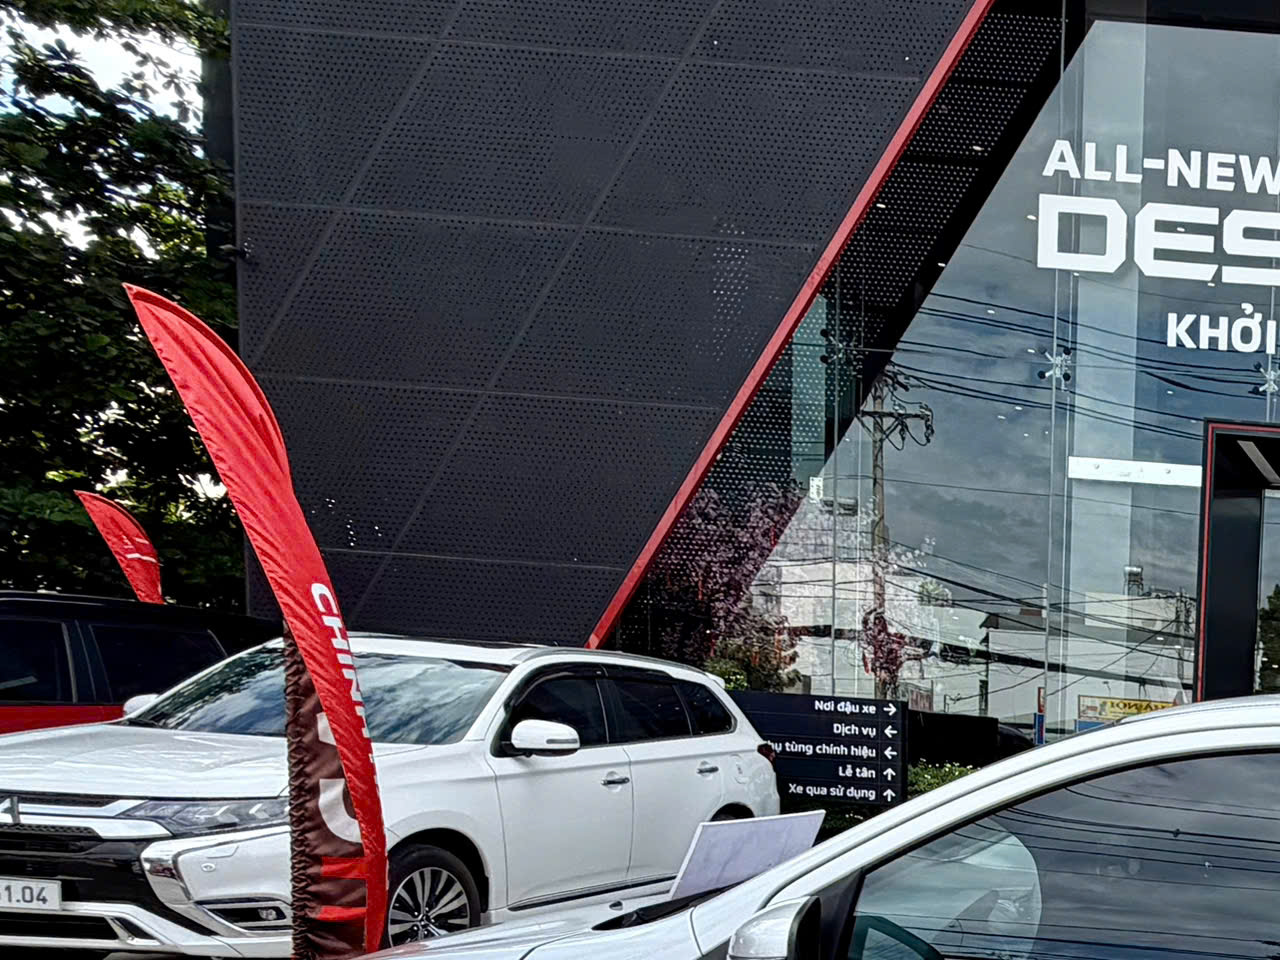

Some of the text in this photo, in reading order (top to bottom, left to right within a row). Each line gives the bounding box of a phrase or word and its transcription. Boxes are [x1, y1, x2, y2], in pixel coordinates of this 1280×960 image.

[1166, 303, 1277, 354] KHỞI
[815, 700, 876, 715] Nơi đậu xe
[833, 723, 877, 738] Dịch vụ
[767, 740, 876, 759] hụ tùng chính hiệu
[855, 766, 876, 778] tân
[788, 783, 876, 800] Xe qua sử dụng
